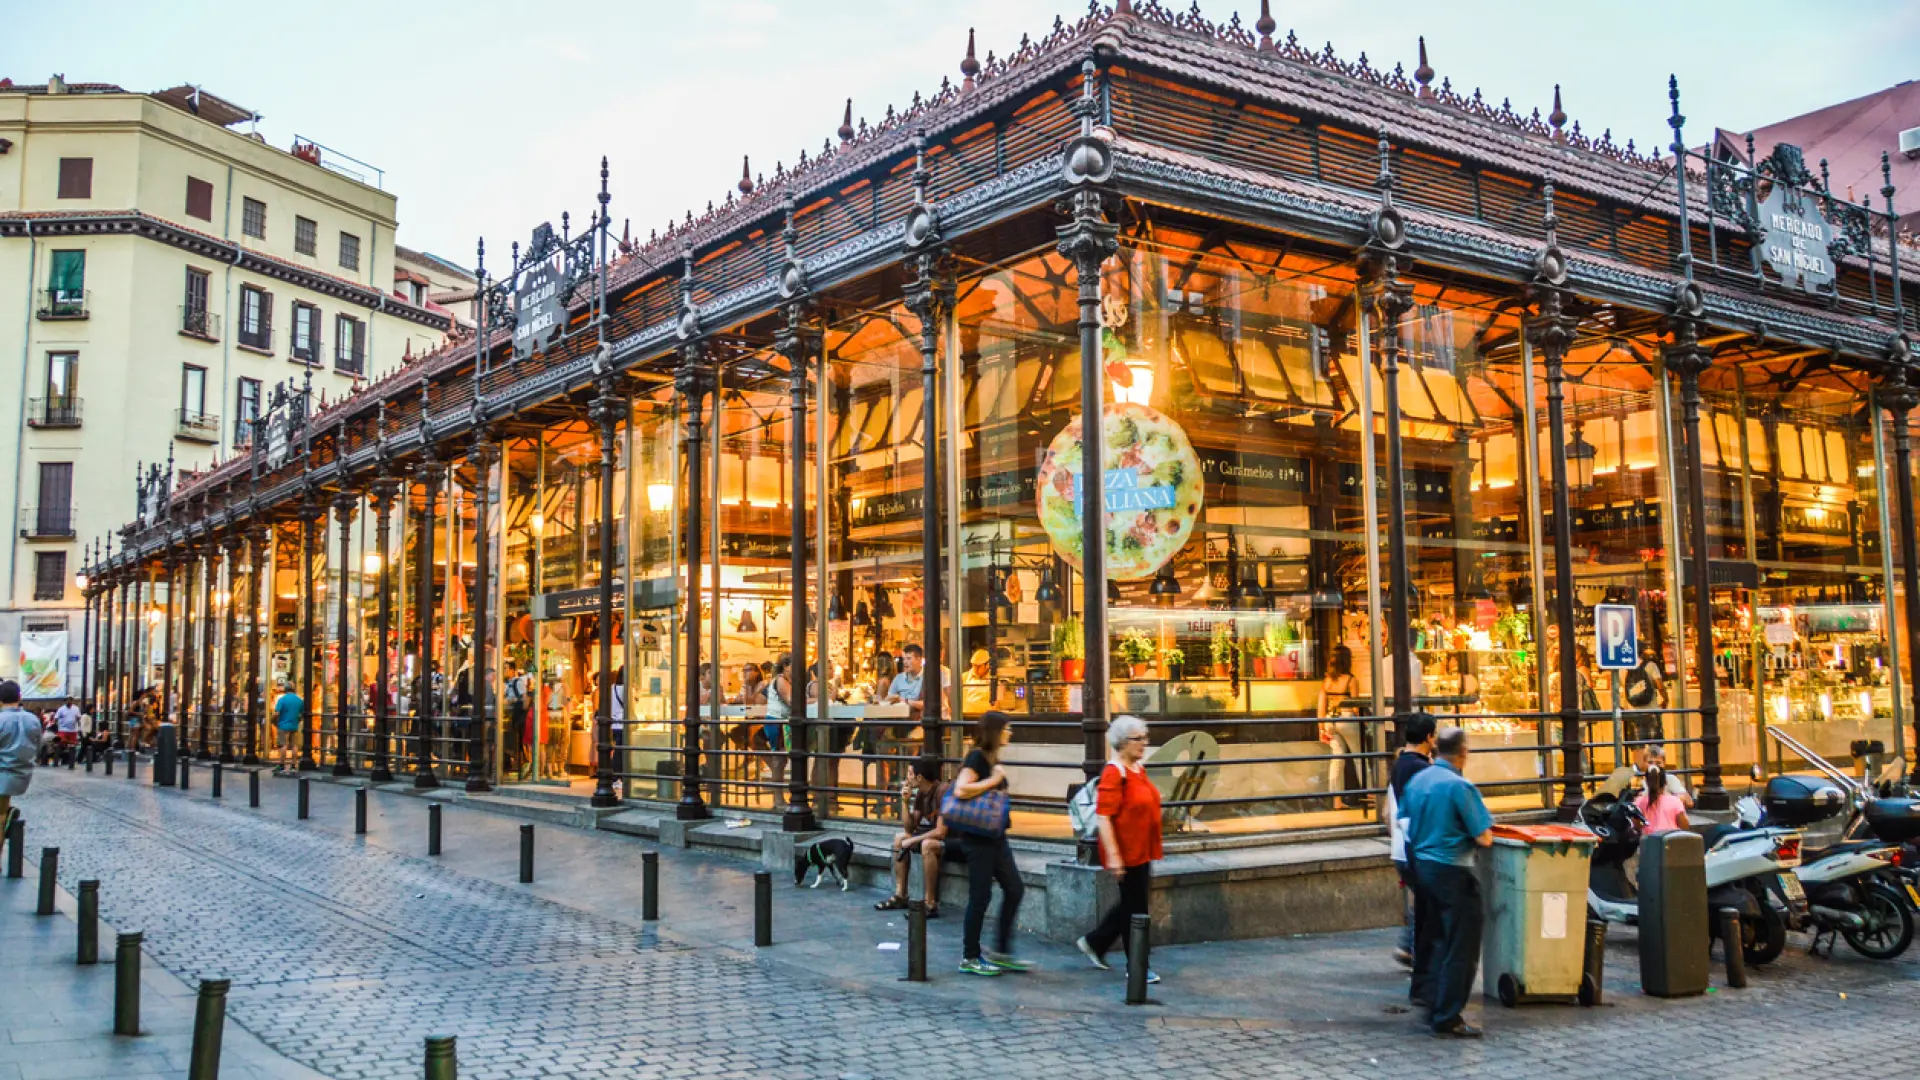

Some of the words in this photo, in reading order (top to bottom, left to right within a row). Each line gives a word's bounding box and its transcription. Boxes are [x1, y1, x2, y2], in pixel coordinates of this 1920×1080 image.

[1771, 213, 1823, 241] MERCADO
[1792, 235, 1807, 250] DE
[1770, 246, 1791, 266] SAN
[1794, 250, 1828, 275] MIGUEL
[521, 281, 556, 311] MERCADO
[532, 303, 542, 317] DE
[516, 323, 530, 340] SAN
[532, 312, 553, 334] MIGUEL
[1219, 460, 1274, 479] Caramelos
[1607, 610, 1625, 661] P
